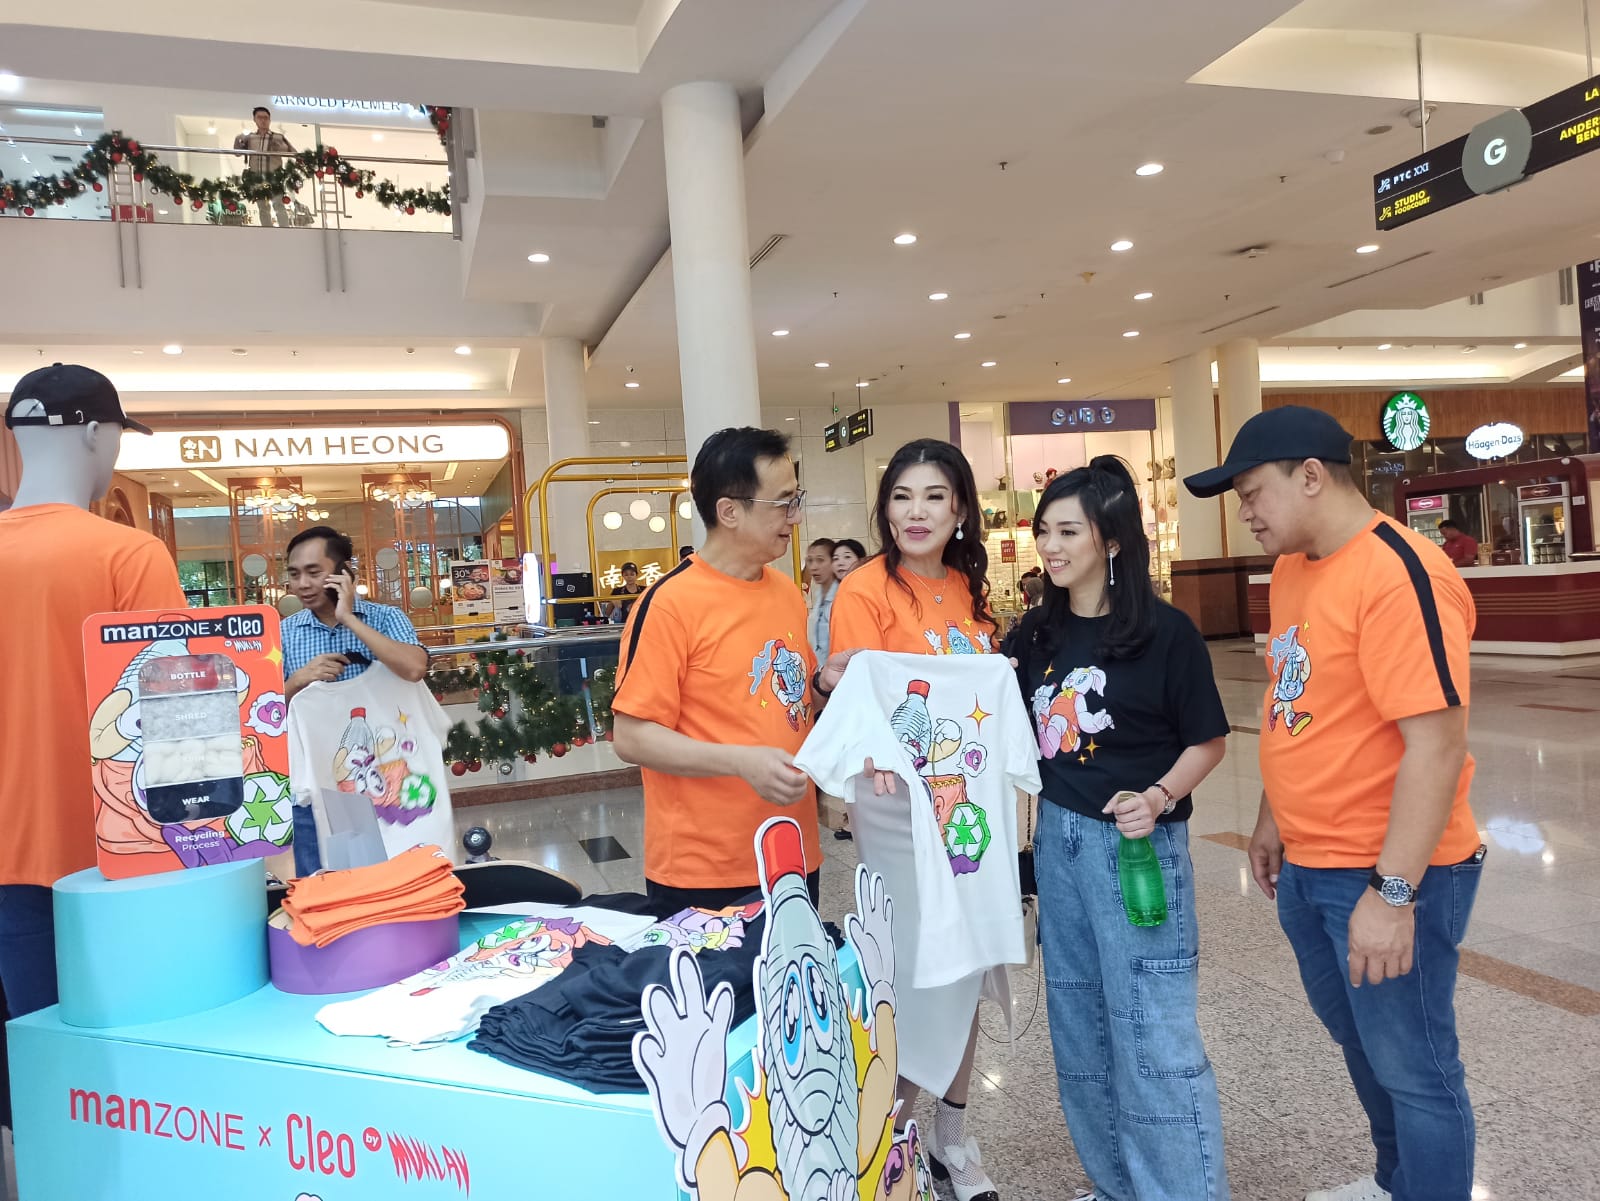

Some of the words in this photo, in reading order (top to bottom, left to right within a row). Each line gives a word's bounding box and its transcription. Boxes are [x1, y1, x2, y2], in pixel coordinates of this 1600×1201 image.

[274, 95, 337, 107] ARNOLD
[342, 99, 401, 111] PALMER
[1560, 116, 1600, 141] ANDER
[1484, 138, 1507, 166] G
[1393, 170, 1411, 185] PTC
[1413, 162, 1429, 177] XXI
[1394, 190, 1426, 209] STUDIO
[1394, 196, 1431, 216] FOODCOURT
[235, 437, 313, 458] NAM
[324, 435, 444, 456] HEONG
[103, 621, 211, 642] manZONE
[228, 616, 262, 637] Cleo
[169, 671, 206, 680] BOTTLE
[175, 711, 207, 721] SHRED
[182, 795, 210, 806] WEAR
[175, 830, 225, 843] Recycling
[69, 1087, 246, 1151] manZONE
[286, 1113, 356, 1179] Cleo
